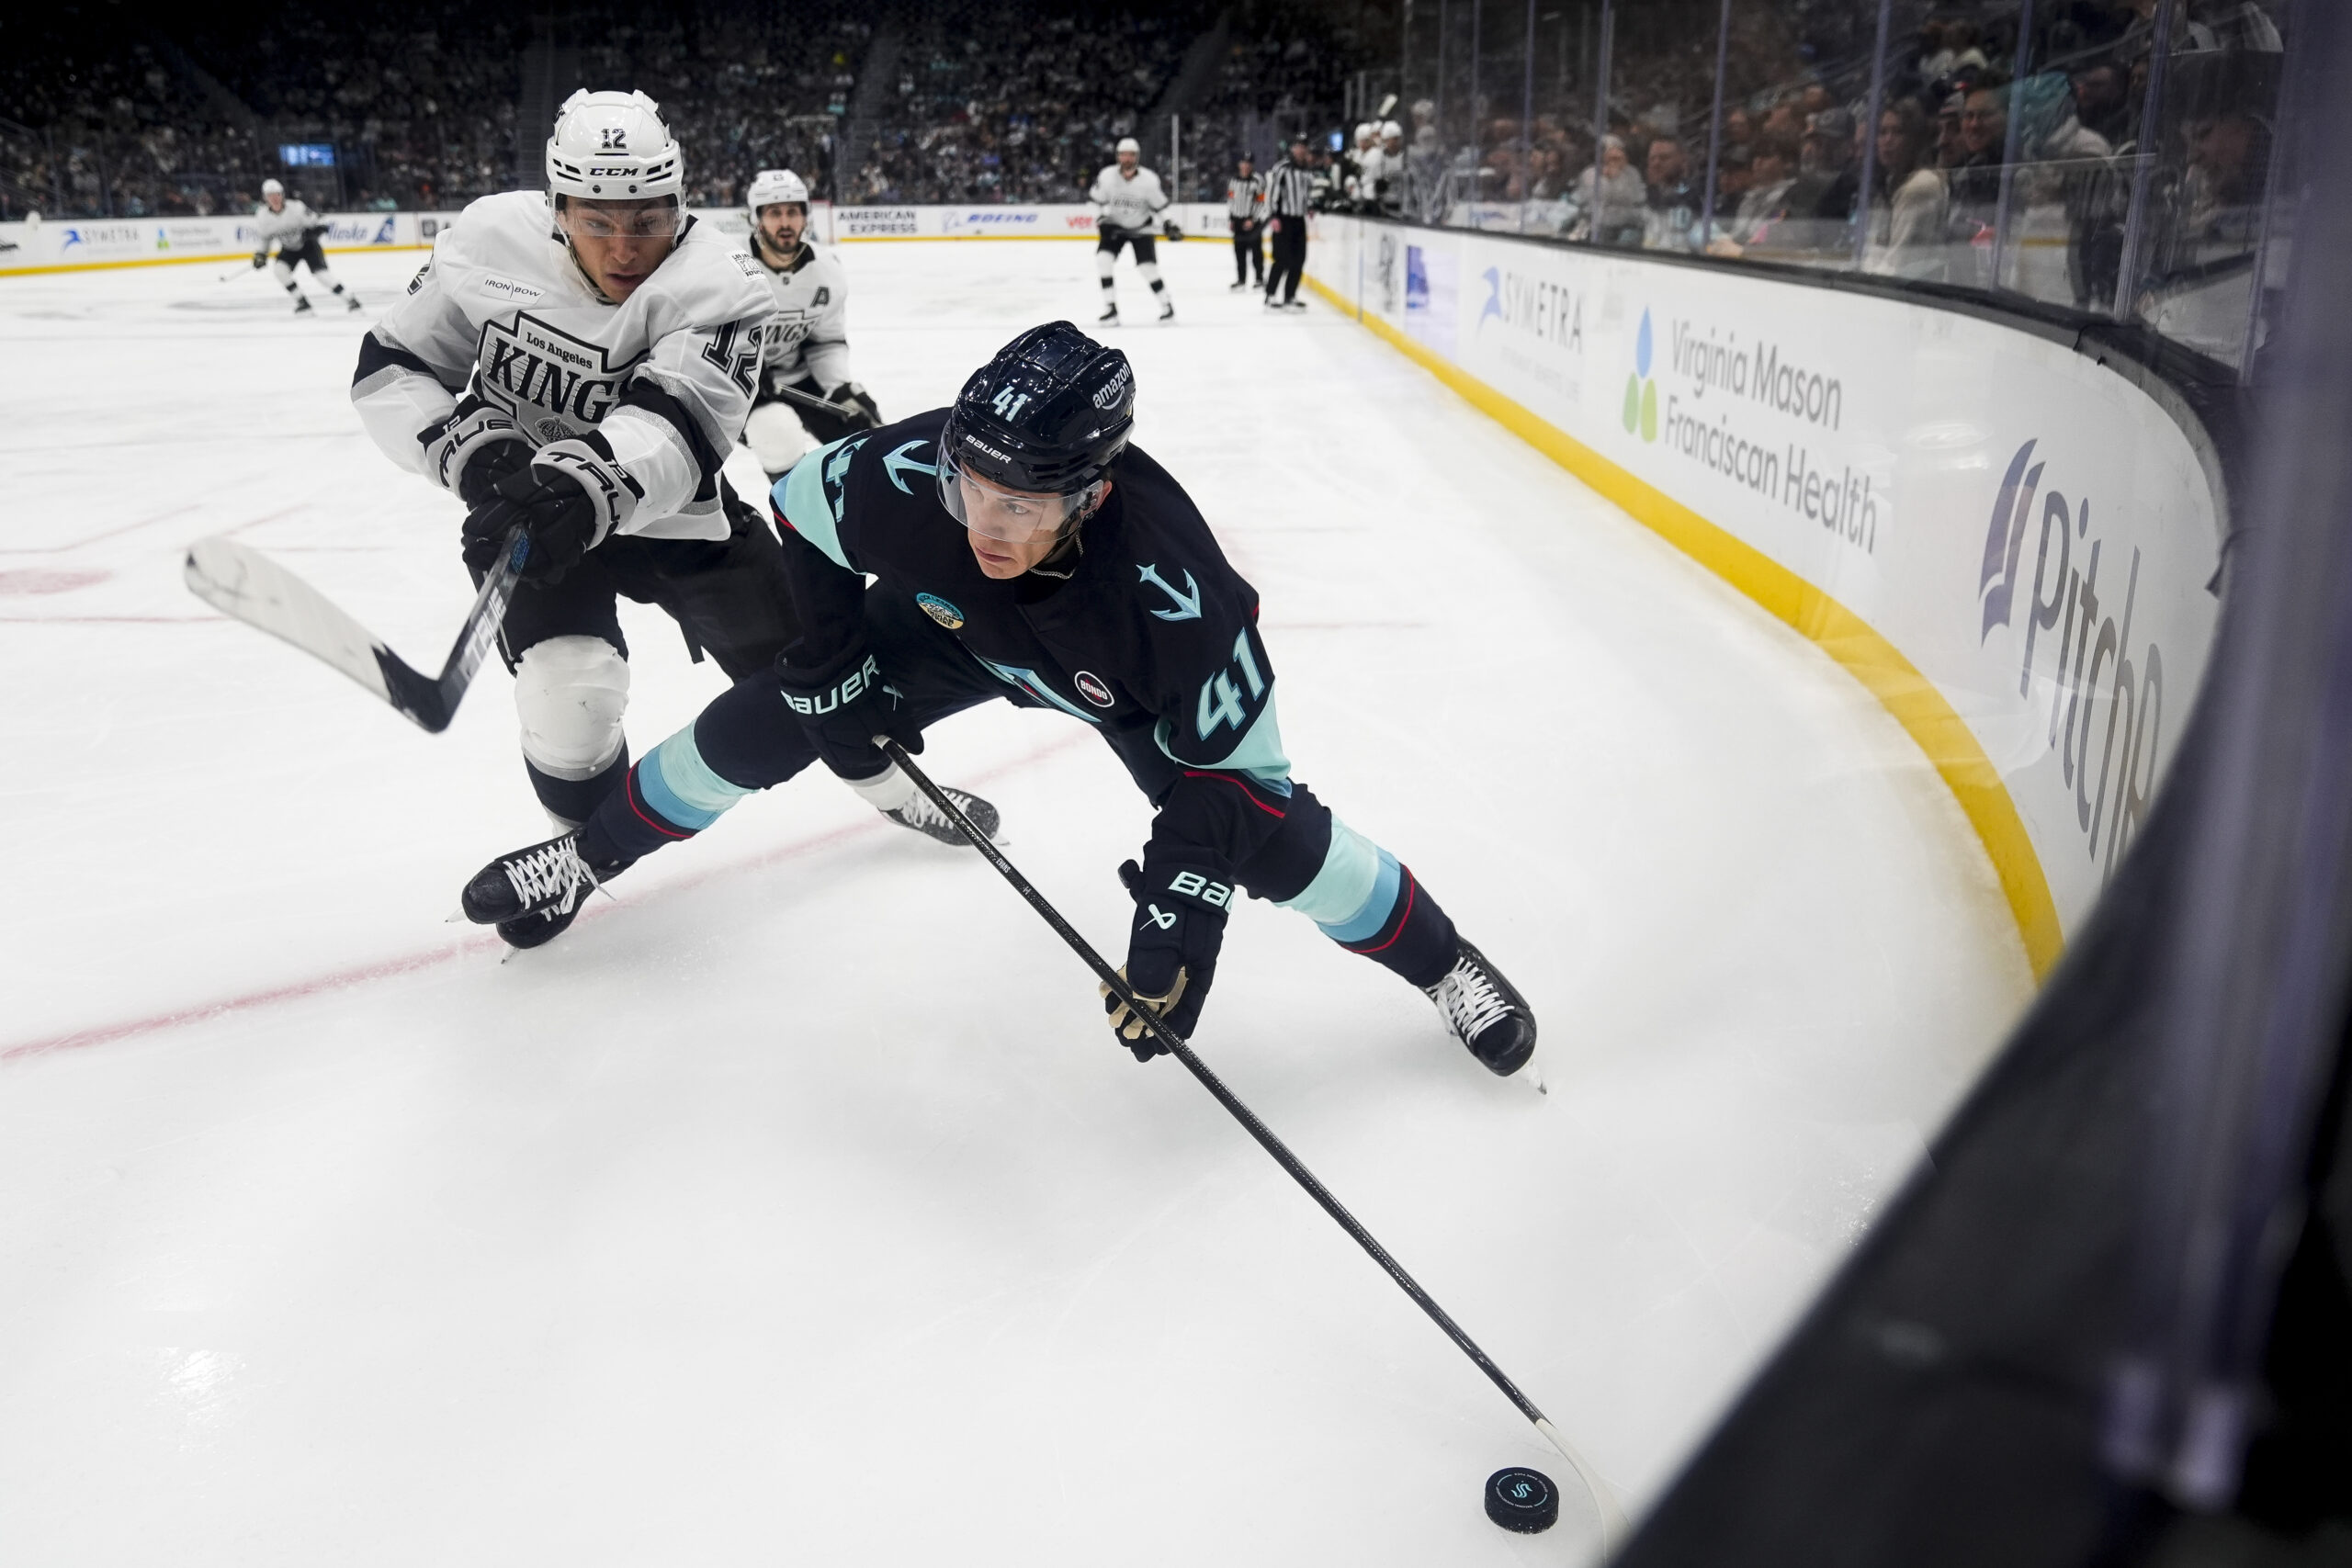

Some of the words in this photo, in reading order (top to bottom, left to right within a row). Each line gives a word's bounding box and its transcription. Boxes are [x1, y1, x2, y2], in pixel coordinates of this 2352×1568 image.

[601, 128, 628, 149] 12
[589, 167, 639, 176] CCM
[839, 211, 915, 221] AMERICAN
[850, 223, 917, 234] EXPRESS
[967, 213, 1038, 223] BOEING
[484, 278, 511, 291] IRON
[514, 286, 542, 298] BOW
[809, 286, 830, 308] A
[1505, 272, 1582, 355] SYMETRA
[526, 332, 545, 349] Los
[547, 341, 593, 369] Angeles
[487, 336, 616, 423] KING
[1092, 363, 1131, 408] amazon
[1672, 318, 1748, 399] Virginia
[1751, 341, 1842, 432] Mason
[992, 385, 1029, 423] 41
[1665, 394, 1779, 501] Franciscan
[1783, 444, 1877, 555] Health
[1080, 679, 1108, 701] BONDO
[1196, 626, 1265, 741] 41
